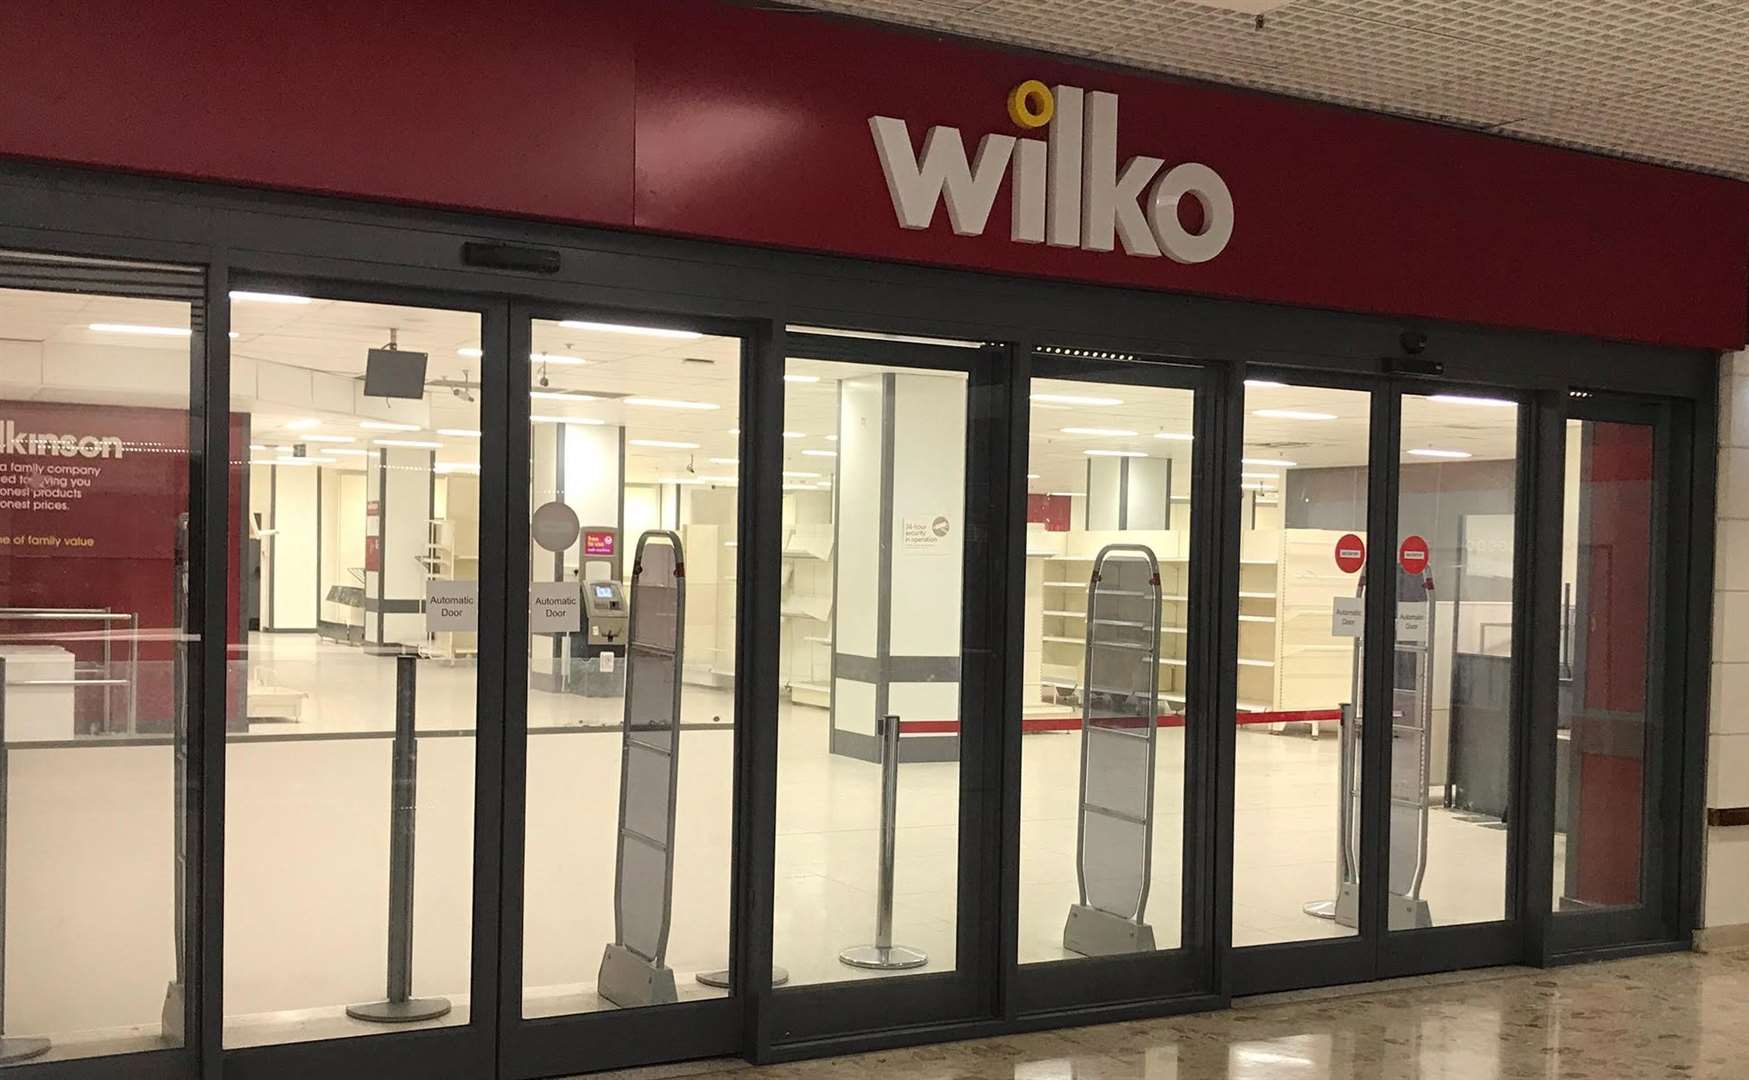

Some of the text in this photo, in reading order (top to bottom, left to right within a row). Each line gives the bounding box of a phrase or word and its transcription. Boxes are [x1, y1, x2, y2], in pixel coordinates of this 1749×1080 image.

[867, 79, 1235, 264] wilko
[11, 463, 44, 474] family
[47, 465, 101, 477] company
[71, 478, 91, 488] you
[0, 487, 82, 498] onest products
[0, 500, 70, 511] onest prices.
[13, 536, 25, 545] of
[28, 536, 61, 547] family
[64, 538, 95, 547] value
[430, 596, 474, 605] Automatic
[535, 597, 577, 606] Automatic
[441, 608, 464, 617] Door
[546, 609, 566, 618] Door
